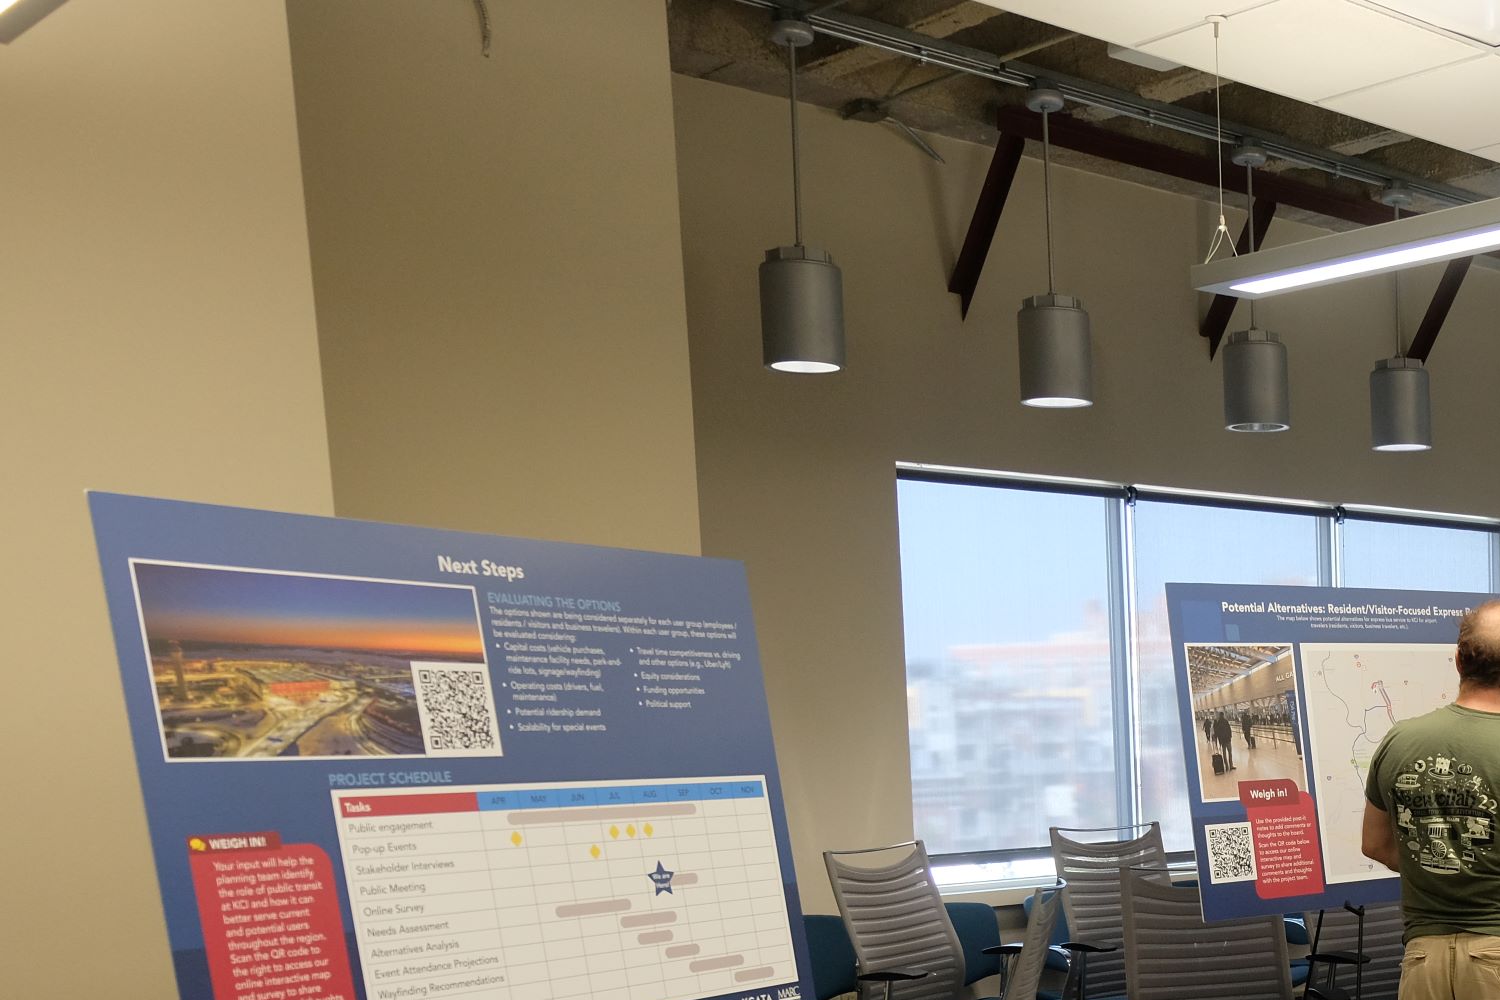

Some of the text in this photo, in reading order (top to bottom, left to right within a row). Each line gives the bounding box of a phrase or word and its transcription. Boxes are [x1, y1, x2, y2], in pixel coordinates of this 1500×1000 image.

[438, 556, 525, 582] Next Steps
[488, 592, 621, 611] EVALUATING THE OPTIONS
[1222, 602, 1265, 612] Potential
[1268, 602, 1326, 614] Alternatives:
[1328, 604, 1431, 615] Resident/Visitor-Focused
[1433, 606, 1463, 618] Express
[328, 771, 452, 786] PROJECT SCHEDULE
[643, 790, 657, 798] AUG
[678, 789, 689, 797] SEP
[710, 787, 722, 795] OCT
[740, 785, 754, 794] NOV
[1250, 788, 1287, 800] Weigh in!
[344, 802, 372, 812] Tasks
[1478, 795, 1498, 814] 22
[349, 820, 433, 833] Public engagement
[209, 837, 267, 849] WEIGH IN!
[352, 842, 417, 856] Pop-up Events
[213, 856, 314, 873] Your input will help the
[356, 860, 455, 875] Stakeholder Interviews
[216, 867, 314, 887] planning team identify
[219, 880, 323, 897] the role of public transit
[360, 883, 426, 895] Public Meeting
[221, 901, 231, 911] at
[233, 899, 249, 909] KCI
[251, 897, 268, 908] and
[270, 897, 289, 906] how
[290, 895, 298, 904] it
[363, 905, 424, 917] Online Survey
[223, 907, 310, 924] better serve current
[226, 922, 310, 939] and potential users
[367, 920, 449, 937] Needs Assessment
[228, 932, 326, 951] throughout the region.
[371, 940, 460, 958] Alternatives Analysis
[230, 945, 320, 963] Scan the QR code to
[233, 959, 329, 977] the right to access our
[374, 955, 499, 979] Event Attendance Projections
[235, 972, 330, 990] online interactive map
[378, 975, 505, 1000] Wayfinding Recommendations
[257, 990, 285, 1000] survey
[287, 987, 297, 996] to
[299, 985, 322, 994] share
[778, 986, 800, 1000] MARC
